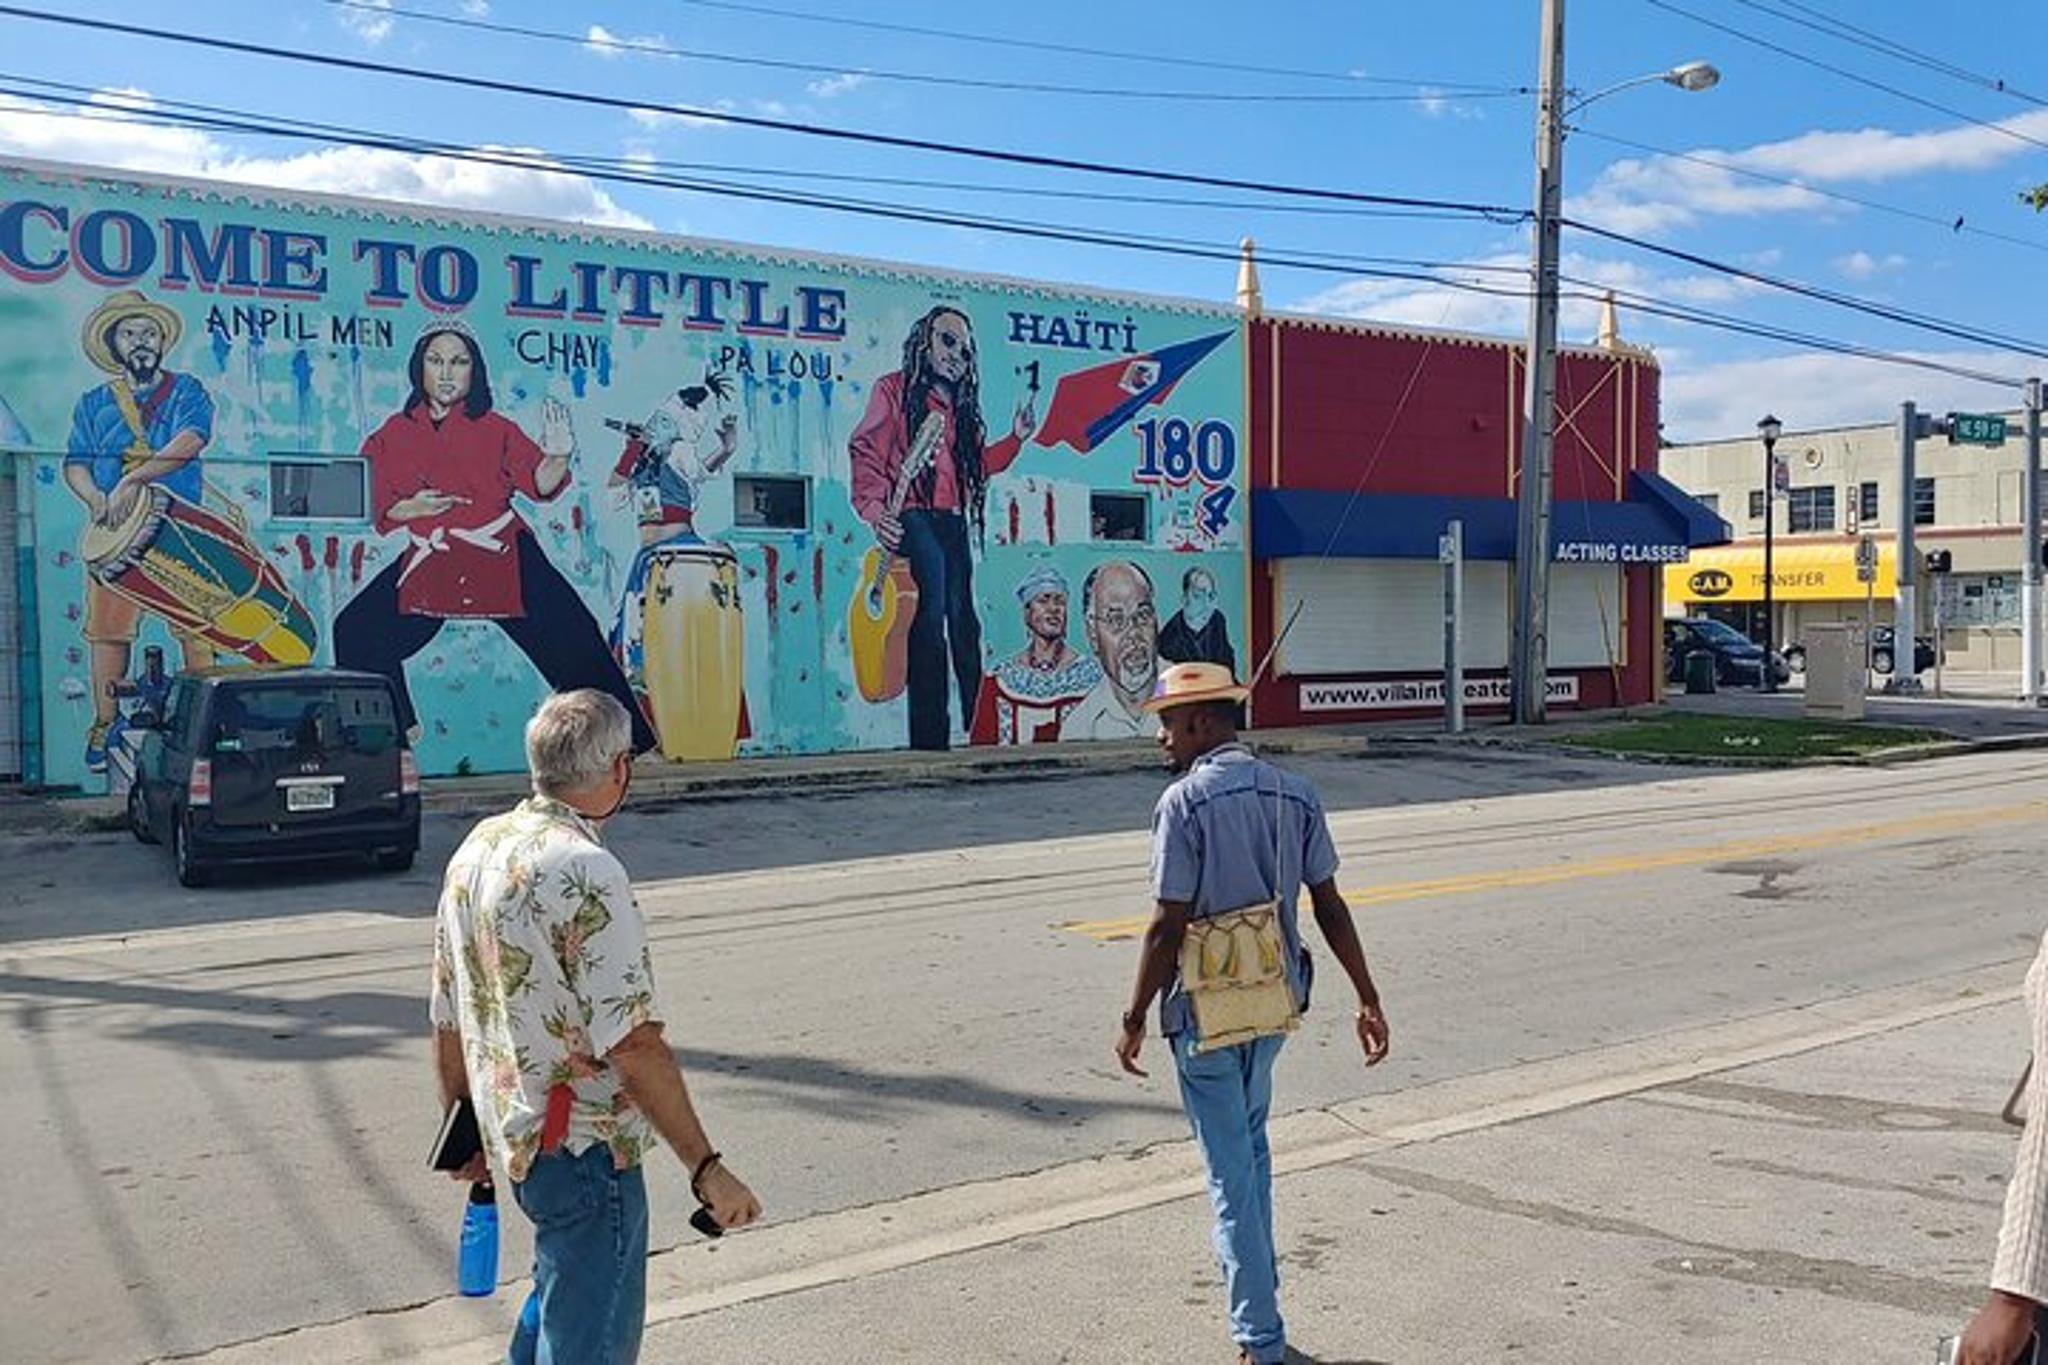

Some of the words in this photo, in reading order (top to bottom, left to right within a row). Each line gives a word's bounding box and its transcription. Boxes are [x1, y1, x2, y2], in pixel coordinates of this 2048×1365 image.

[353, 239, 478, 314] TO
[505, 254, 847, 341] LITTLE
[332, 314, 393, 347] MEN
[517, 330, 599, 373] CHAY
[719, 346, 754, 373] PA
[1556, 542, 1617, 561] ACTING
[1620, 545, 1688, 562] CLASSES
